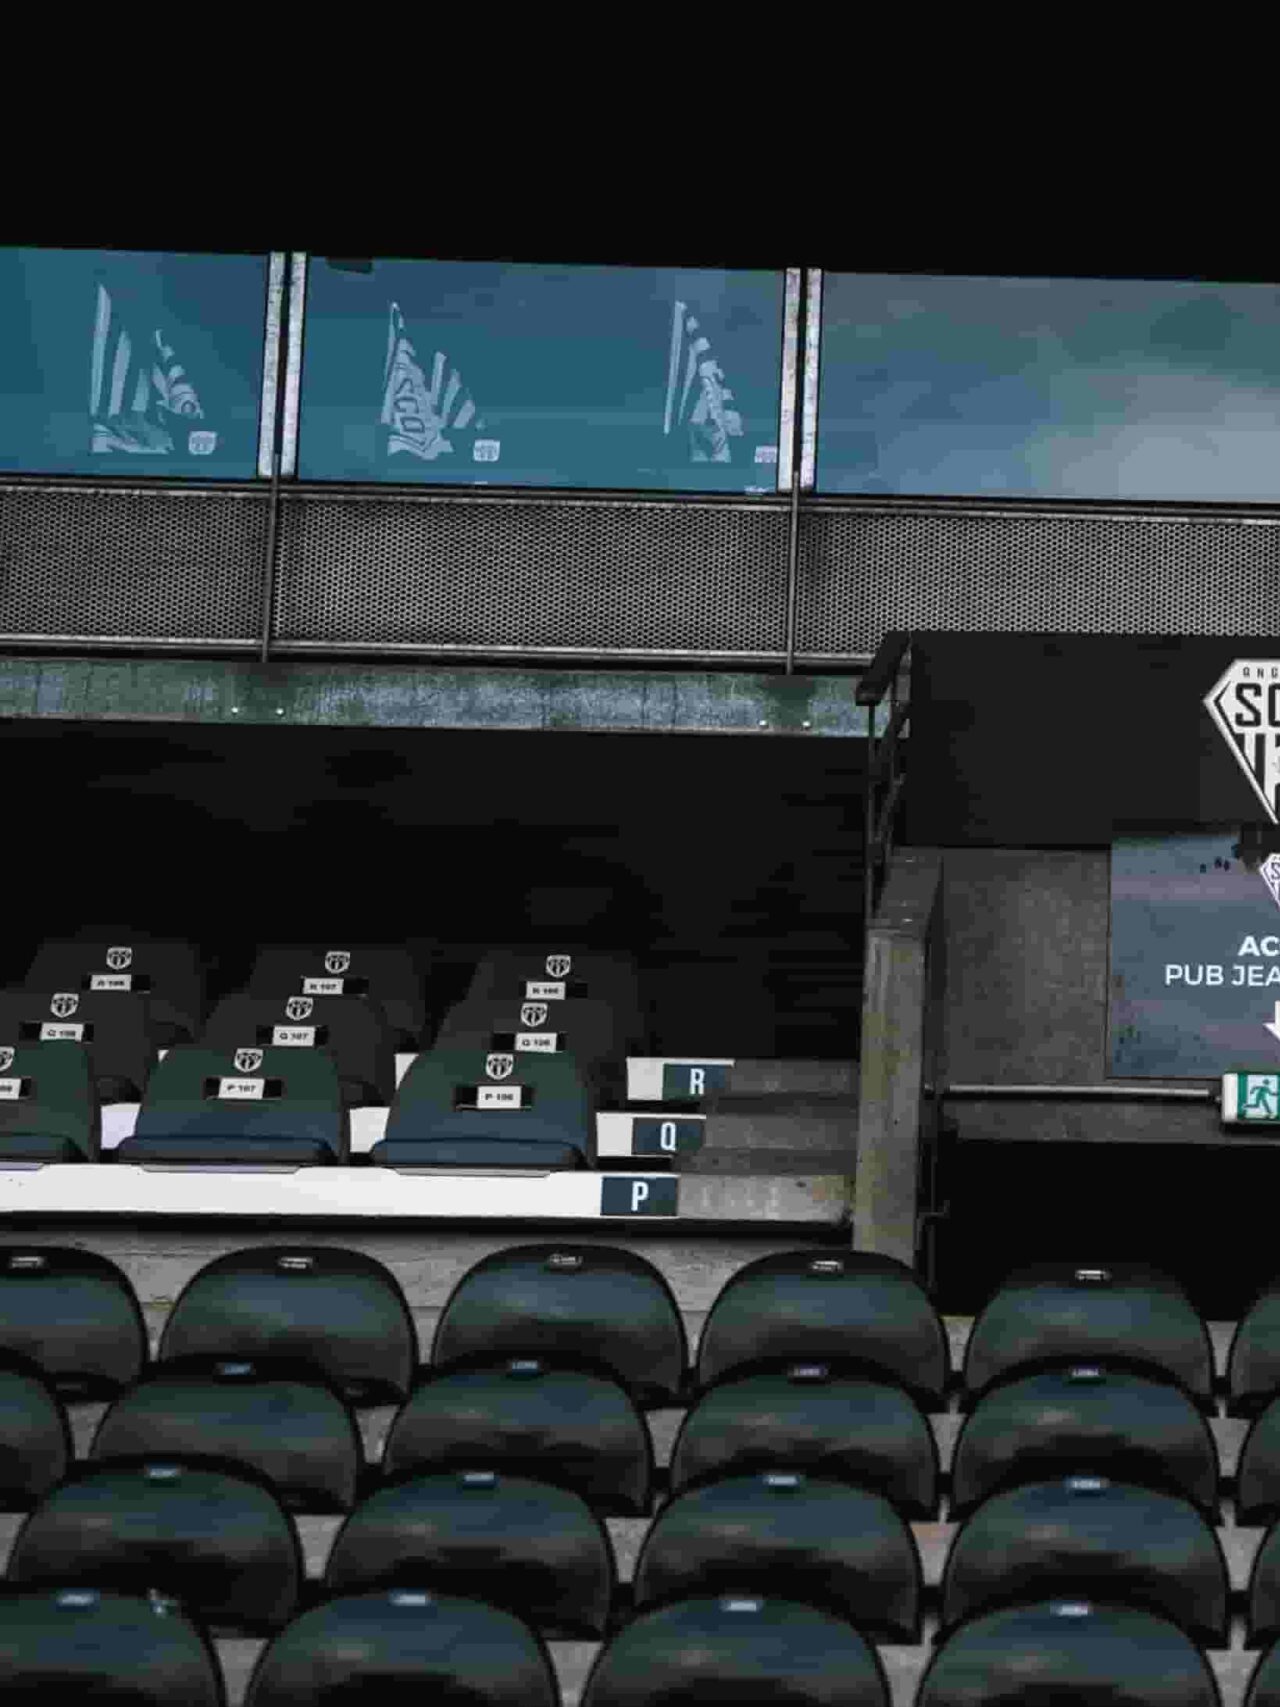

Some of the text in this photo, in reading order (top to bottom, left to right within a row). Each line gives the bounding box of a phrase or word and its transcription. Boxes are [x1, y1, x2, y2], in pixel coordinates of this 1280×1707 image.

[1164, 964, 1224, 986] PUB
[689, 1068, 705, 1095] R
[660, 1121, 676, 1151] Q
[630, 1180, 649, 1212] P
